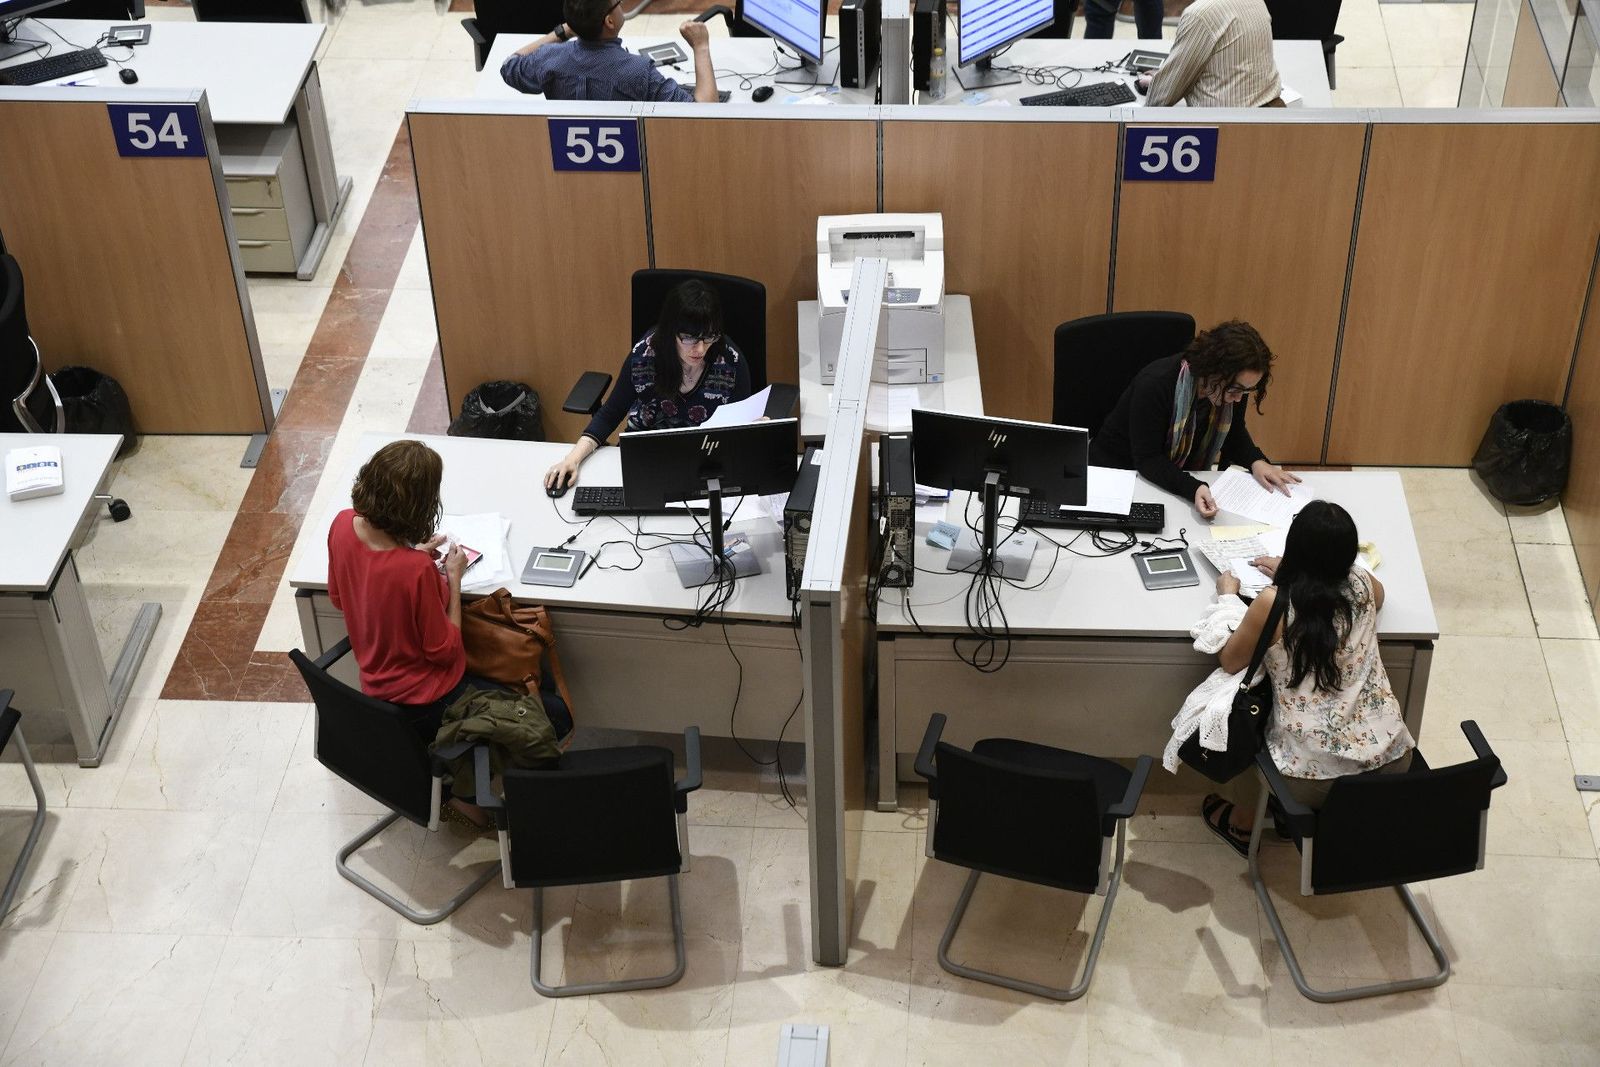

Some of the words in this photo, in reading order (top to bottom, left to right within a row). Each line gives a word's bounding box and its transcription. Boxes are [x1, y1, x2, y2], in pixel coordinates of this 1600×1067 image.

[127, 112, 189, 150] 54
[566, 126, 625, 164] 55
[1139, 135, 1201, 173] 56
